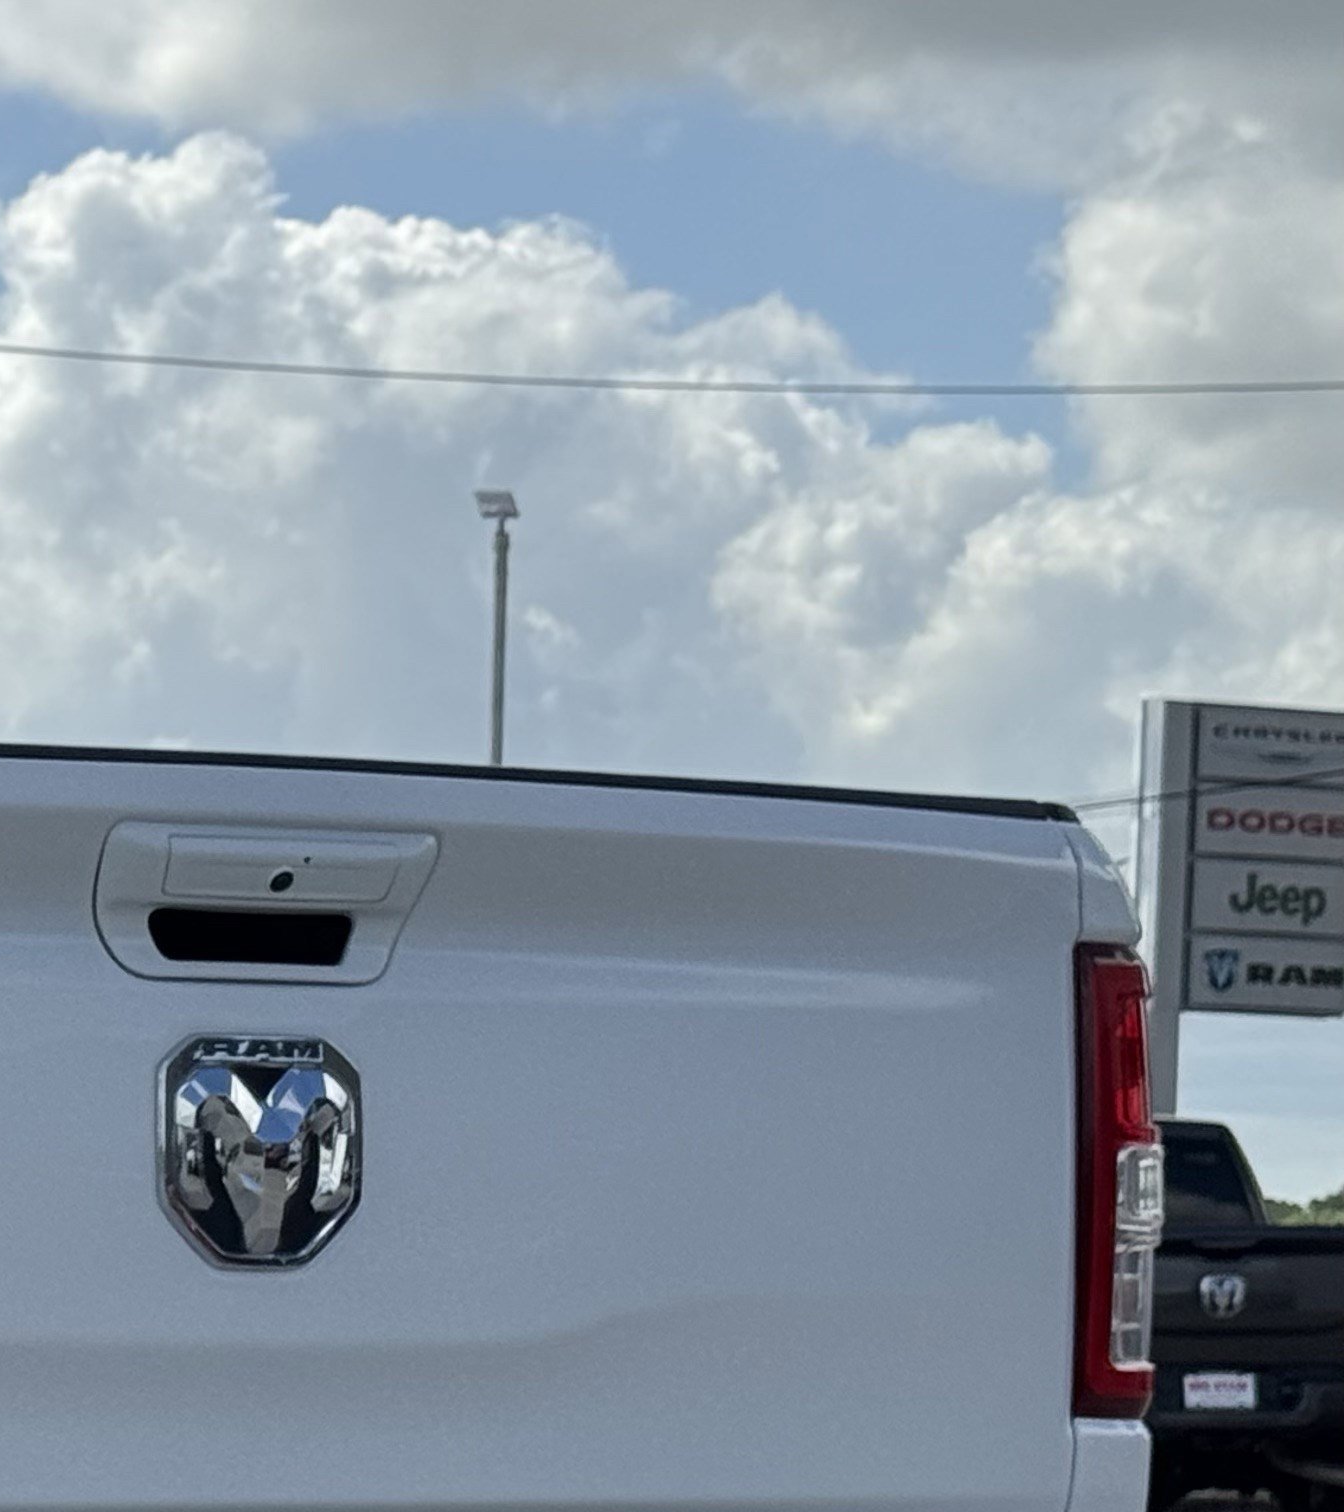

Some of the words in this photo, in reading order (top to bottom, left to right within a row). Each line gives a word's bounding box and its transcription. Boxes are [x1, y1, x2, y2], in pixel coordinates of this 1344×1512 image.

[1208, 808, 1344, 836] DODGE
[1229, 872, 1326, 925] Jeep
[1247, 962, 1344, 988] RAM
